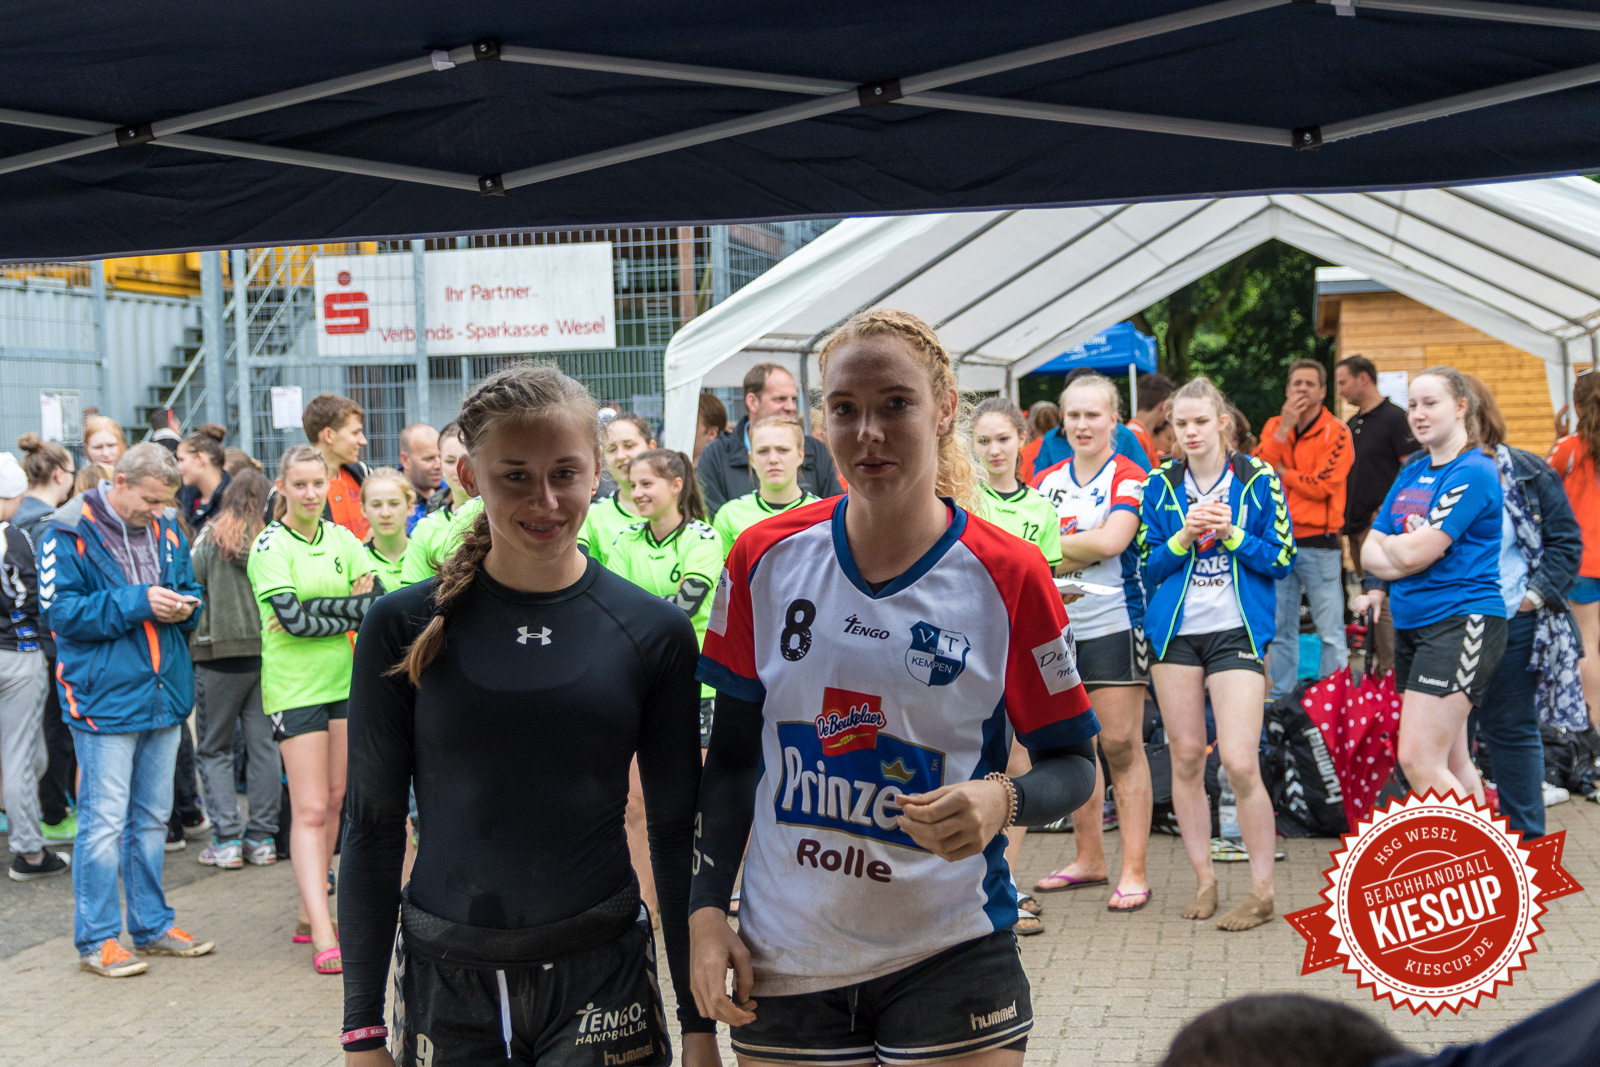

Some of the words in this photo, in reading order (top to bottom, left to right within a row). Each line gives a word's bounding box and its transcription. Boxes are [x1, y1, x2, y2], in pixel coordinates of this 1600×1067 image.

[445, 285, 465, 302] Ihr
[557, 316, 606, 335] Wesel
[1023, 521, 1039, 542] 12
[670, 562, 681, 583] 6
[780, 598, 817, 662] 8
[843, 614, 890, 640] TENGO
[911, 656, 953, 674] KEMPEN
[1303, 726, 1344, 805] hummel
[781, 746, 904, 832] Prinze
[797, 838, 893, 883] Rolle
[576, 1003, 642, 1034] TENGO
[970, 999, 1018, 1031] hummel
[415, 1033, 434, 1067] 9
[603, 1039, 655, 1066] hummel
